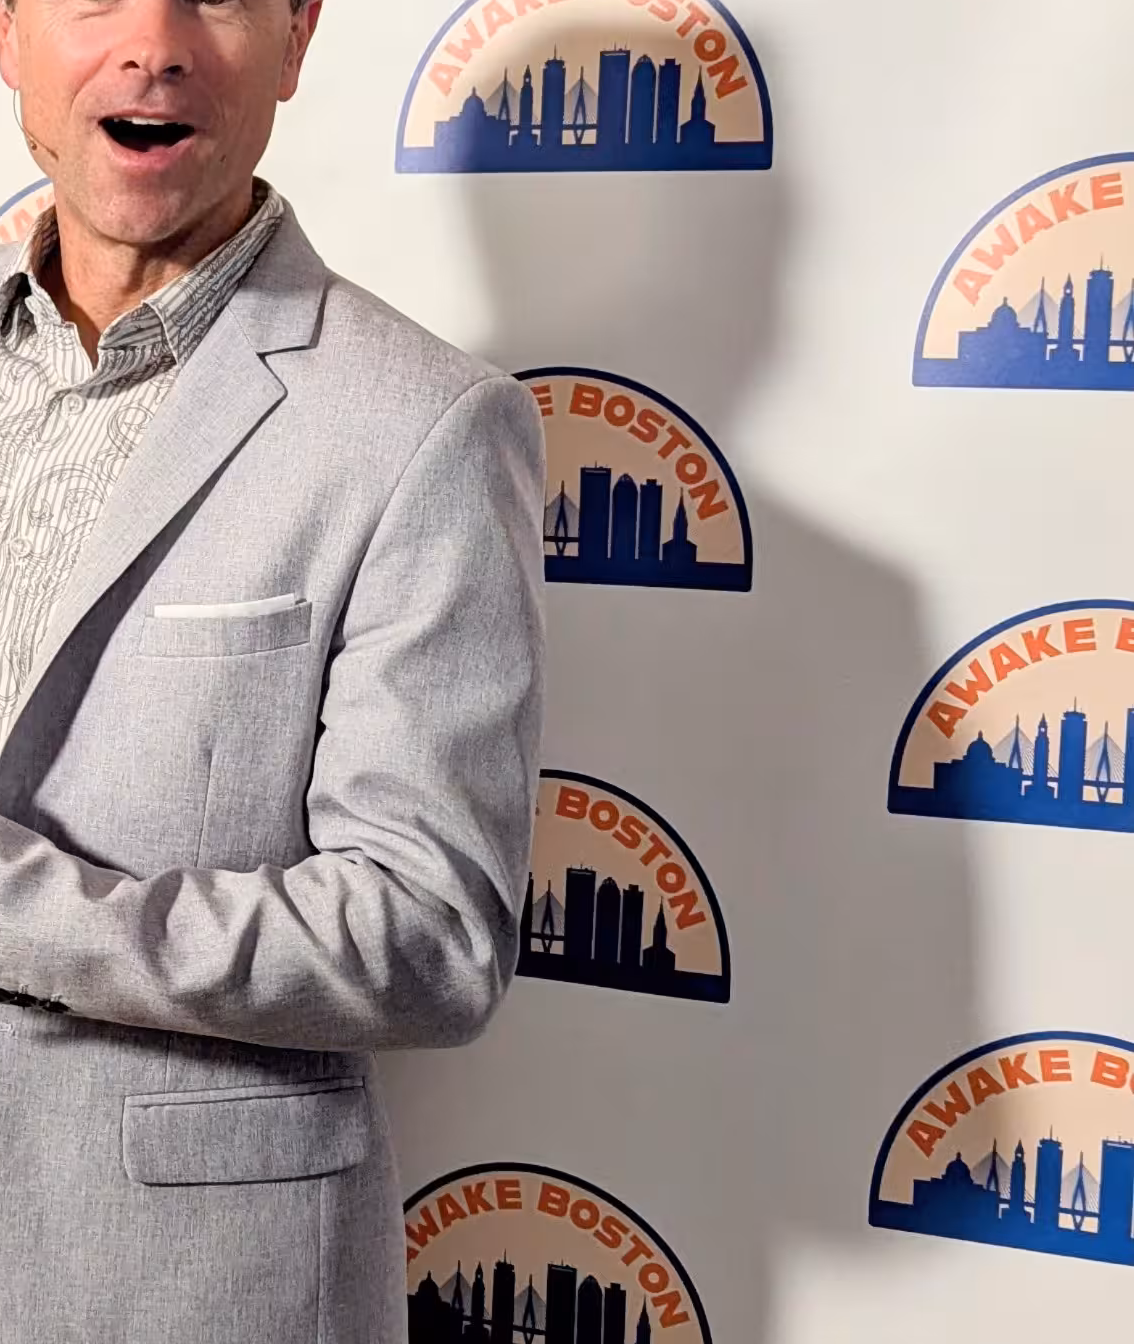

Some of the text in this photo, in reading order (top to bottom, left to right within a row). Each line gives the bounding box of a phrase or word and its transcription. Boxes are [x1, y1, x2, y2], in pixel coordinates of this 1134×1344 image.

[953, 172, 1124, 305] AWAKE
[569, 382, 729, 521] BOSTON
[926, 618, 1097, 739] AWAKE
[555, 785, 707, 930] BOSTON
[905, 1049, 1073, 1159] AWAKE
[535, 1184, 691, 1330] BOSTON
